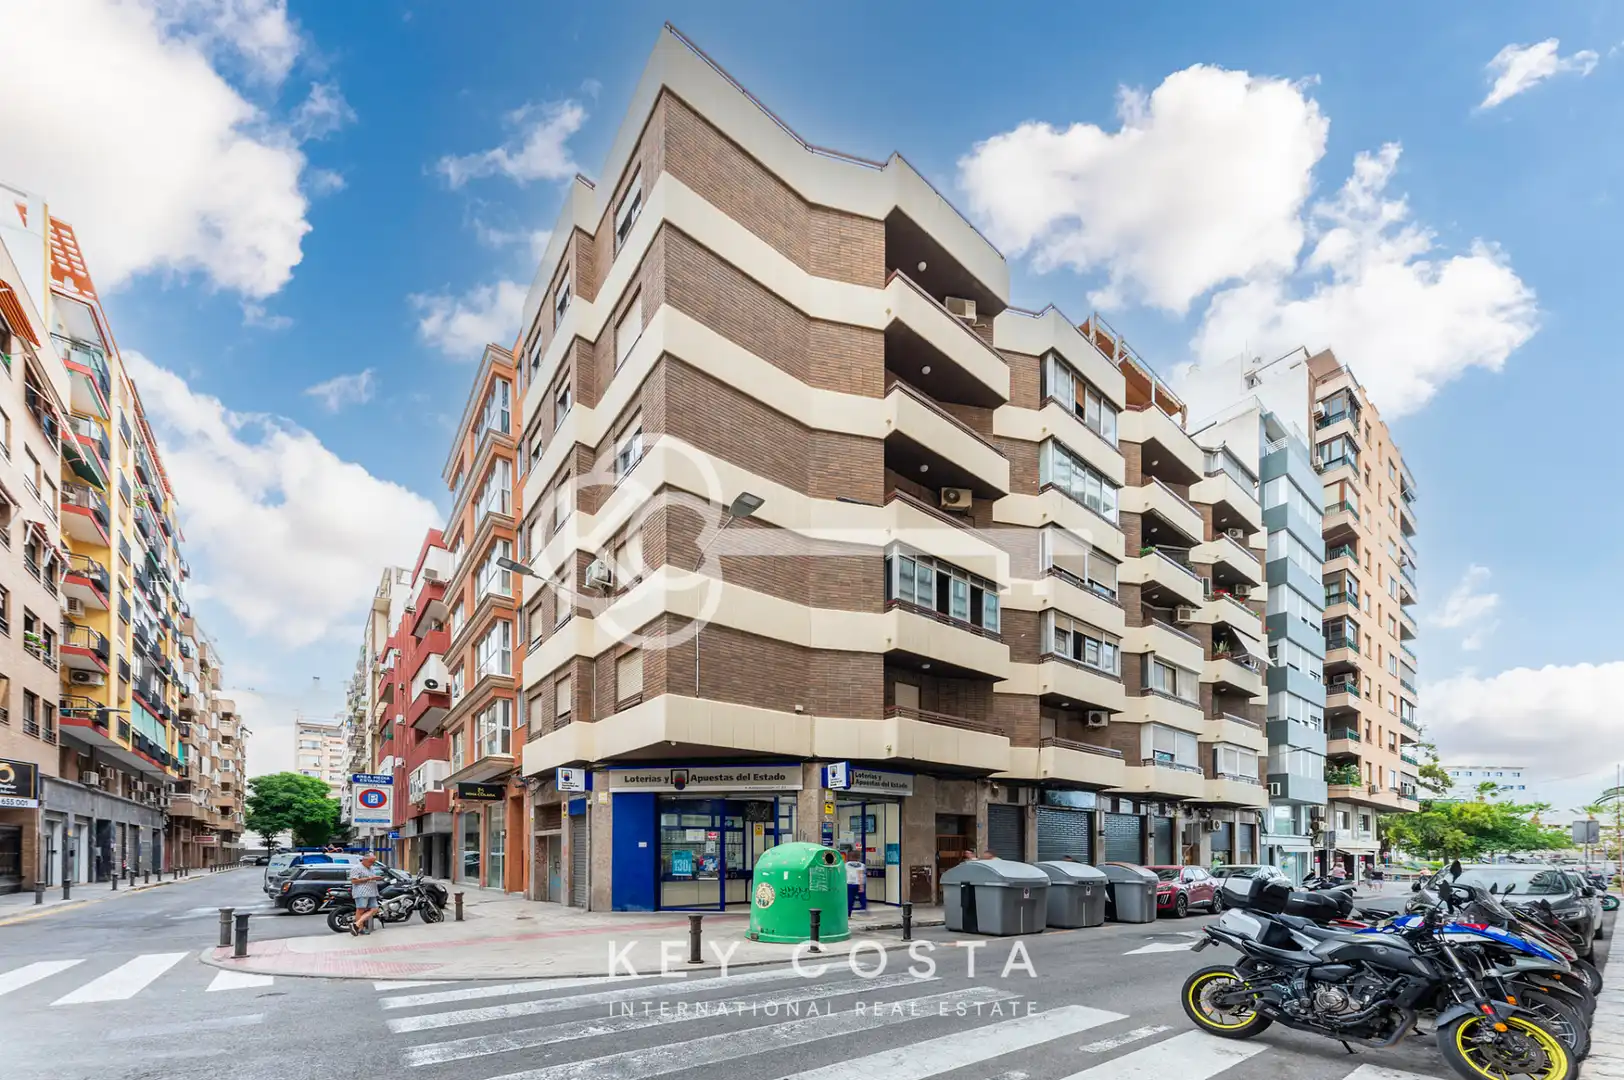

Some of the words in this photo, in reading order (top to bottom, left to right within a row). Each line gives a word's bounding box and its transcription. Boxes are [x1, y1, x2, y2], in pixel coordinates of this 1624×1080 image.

[664, 775, 670, 784] y
[690, 773, 734, 783] Apuestas
[736, 773, 751, 781] del
[753, 773, 786, 781] Estado
